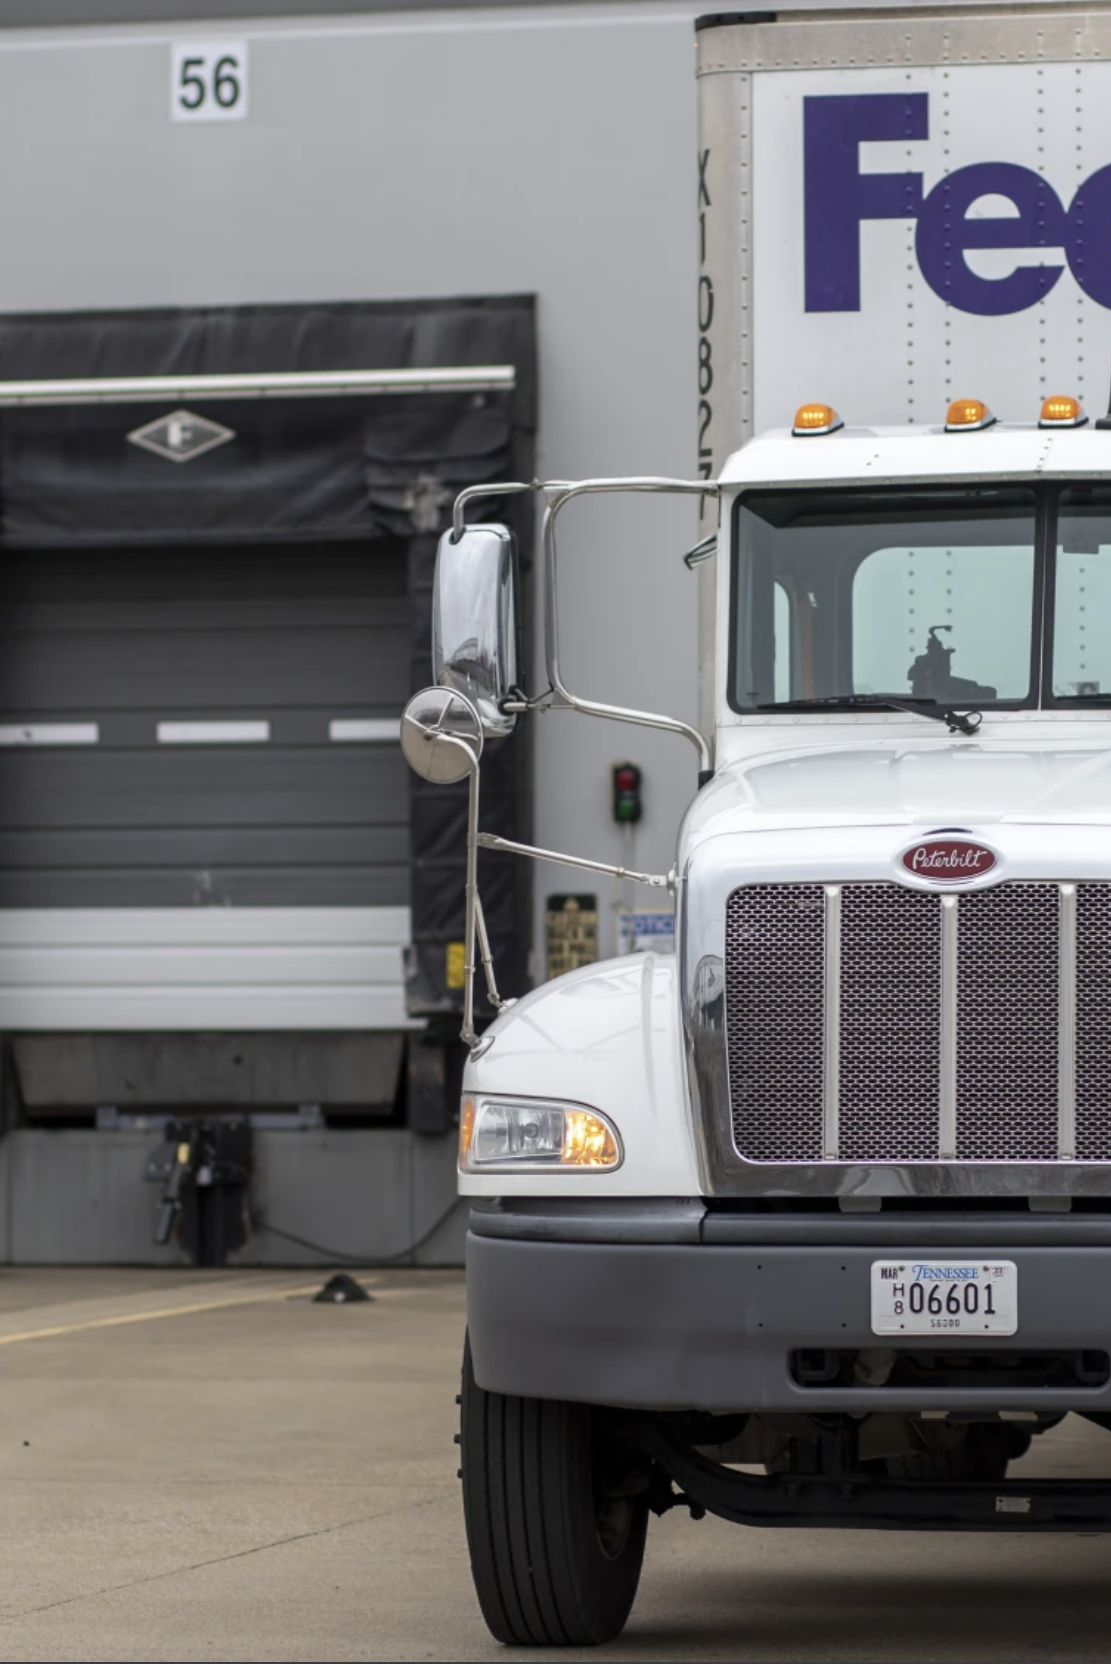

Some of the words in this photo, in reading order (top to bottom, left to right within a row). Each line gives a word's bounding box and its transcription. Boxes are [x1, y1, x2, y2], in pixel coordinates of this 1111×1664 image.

[180, 56, 240, 109] 56
[912, 847, 988, 870] Peterbilt
[881, 1268, 898, 1280] MAR
[909, 1282, 996, 1315] 06601
